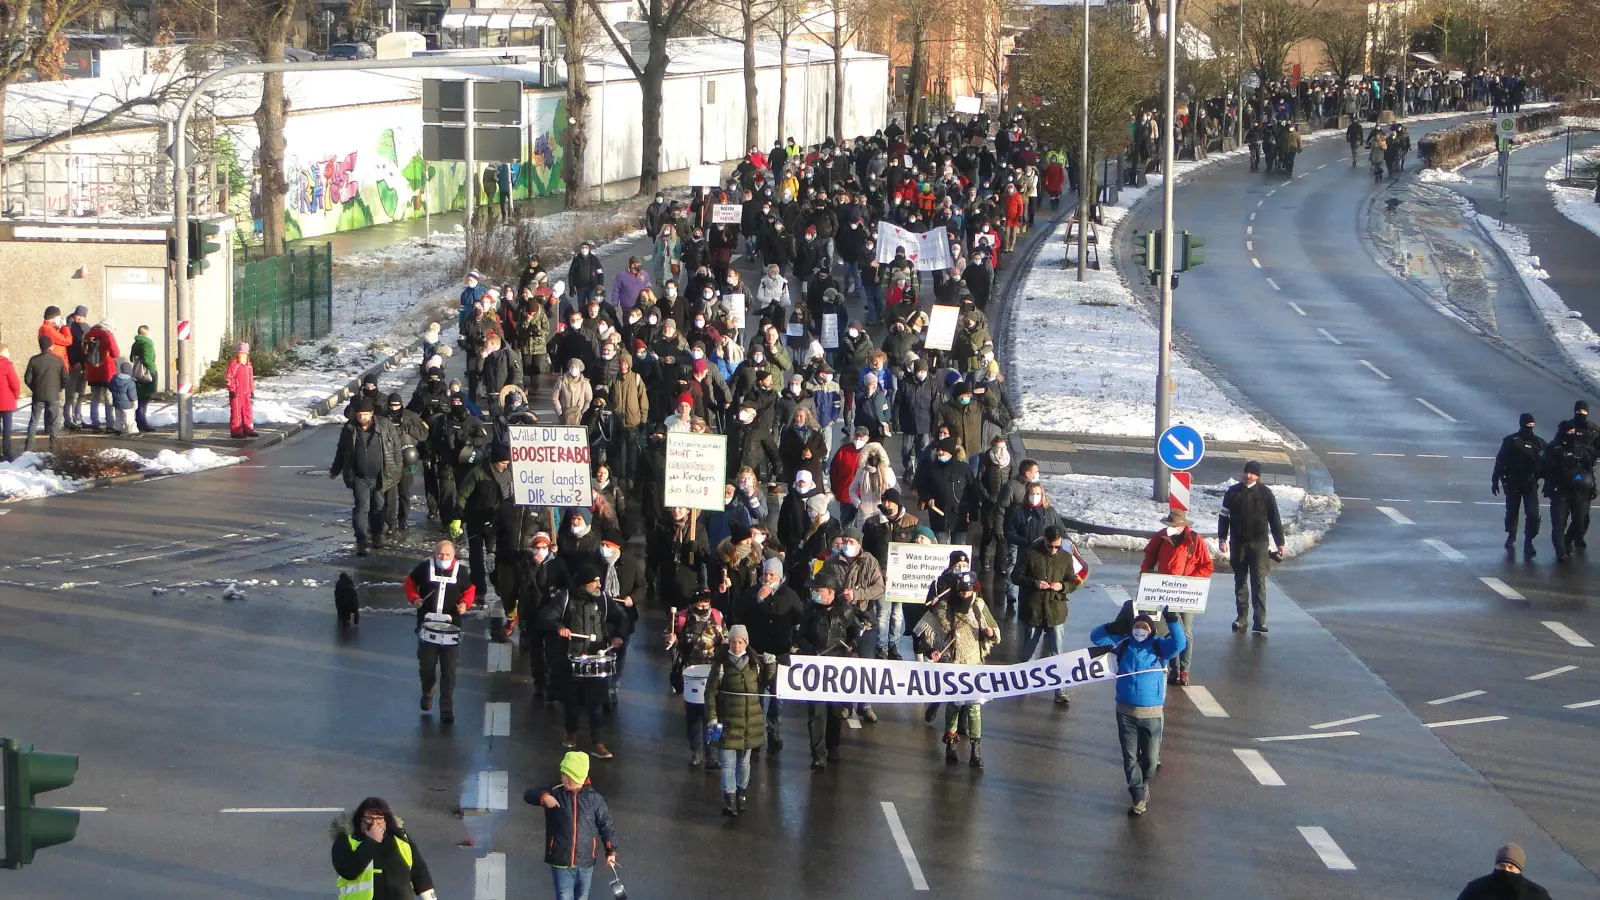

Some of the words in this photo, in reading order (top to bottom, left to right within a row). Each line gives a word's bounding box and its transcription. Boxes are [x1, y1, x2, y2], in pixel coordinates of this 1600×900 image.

[509, 428, 538, 442] Willst
[542, 428, 557, 442] DU
[563, 428, 580, 442] das
[669, 448, 691, 458] Stoff
[520, 469, 545, 484] Oder
[552, 468, 584, 491] langt's
[683, 471, 715, 482] Kindern
[528, 488, 546, 503] DIR
[906, 552, 922, 561] Was
[924, 553, 950, 561] brauch
[891, 581, 919, 589] kranke
[1161, 580, 1188, 588] Keine
[1143, 587, 1203, 596] Impfexperimente
[1158, 595, 1199, 604] Kindern!
[787, 658, 1104, 697] CORONA-AUSSCHUSS.de
